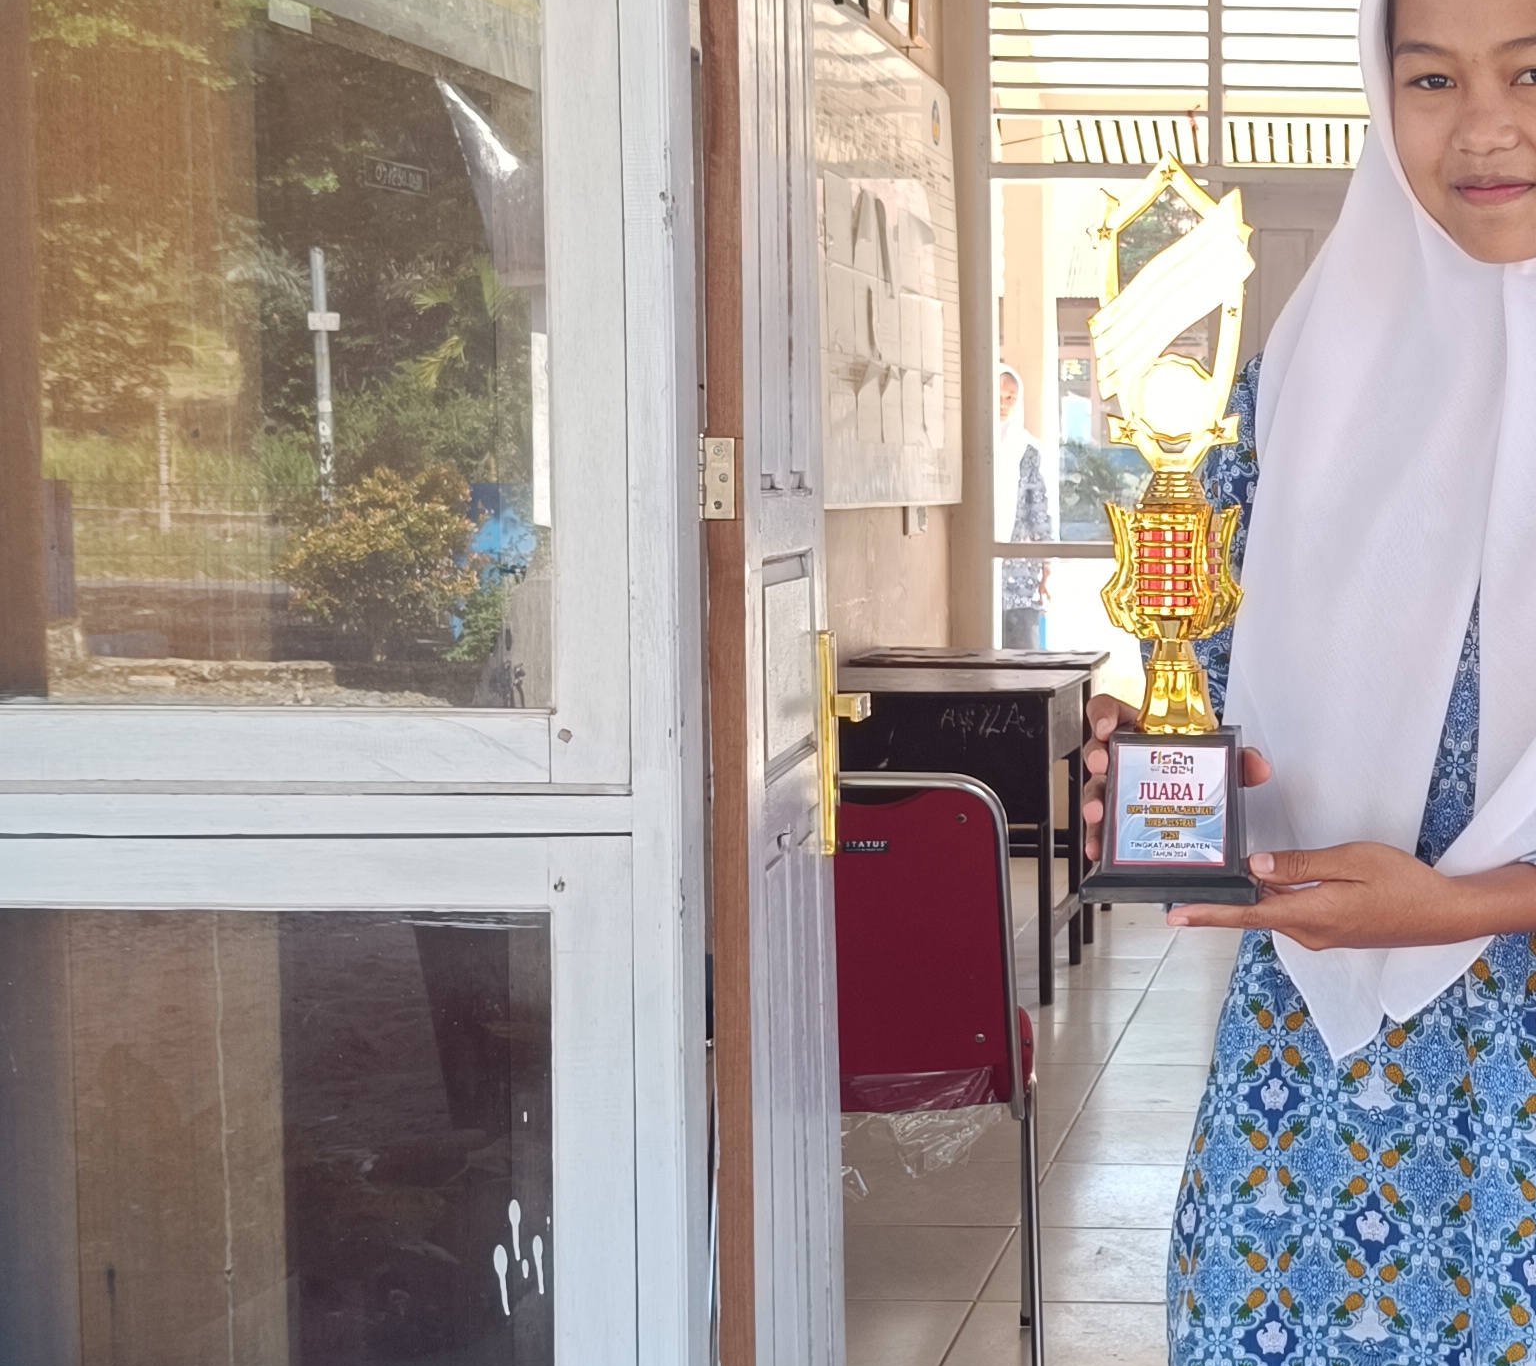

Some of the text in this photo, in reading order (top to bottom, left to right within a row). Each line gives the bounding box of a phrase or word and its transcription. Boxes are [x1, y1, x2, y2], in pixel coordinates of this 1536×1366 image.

[1162, 765, 1194, 774] 2024
[1138, 782, 1204, 801] JUARA I
